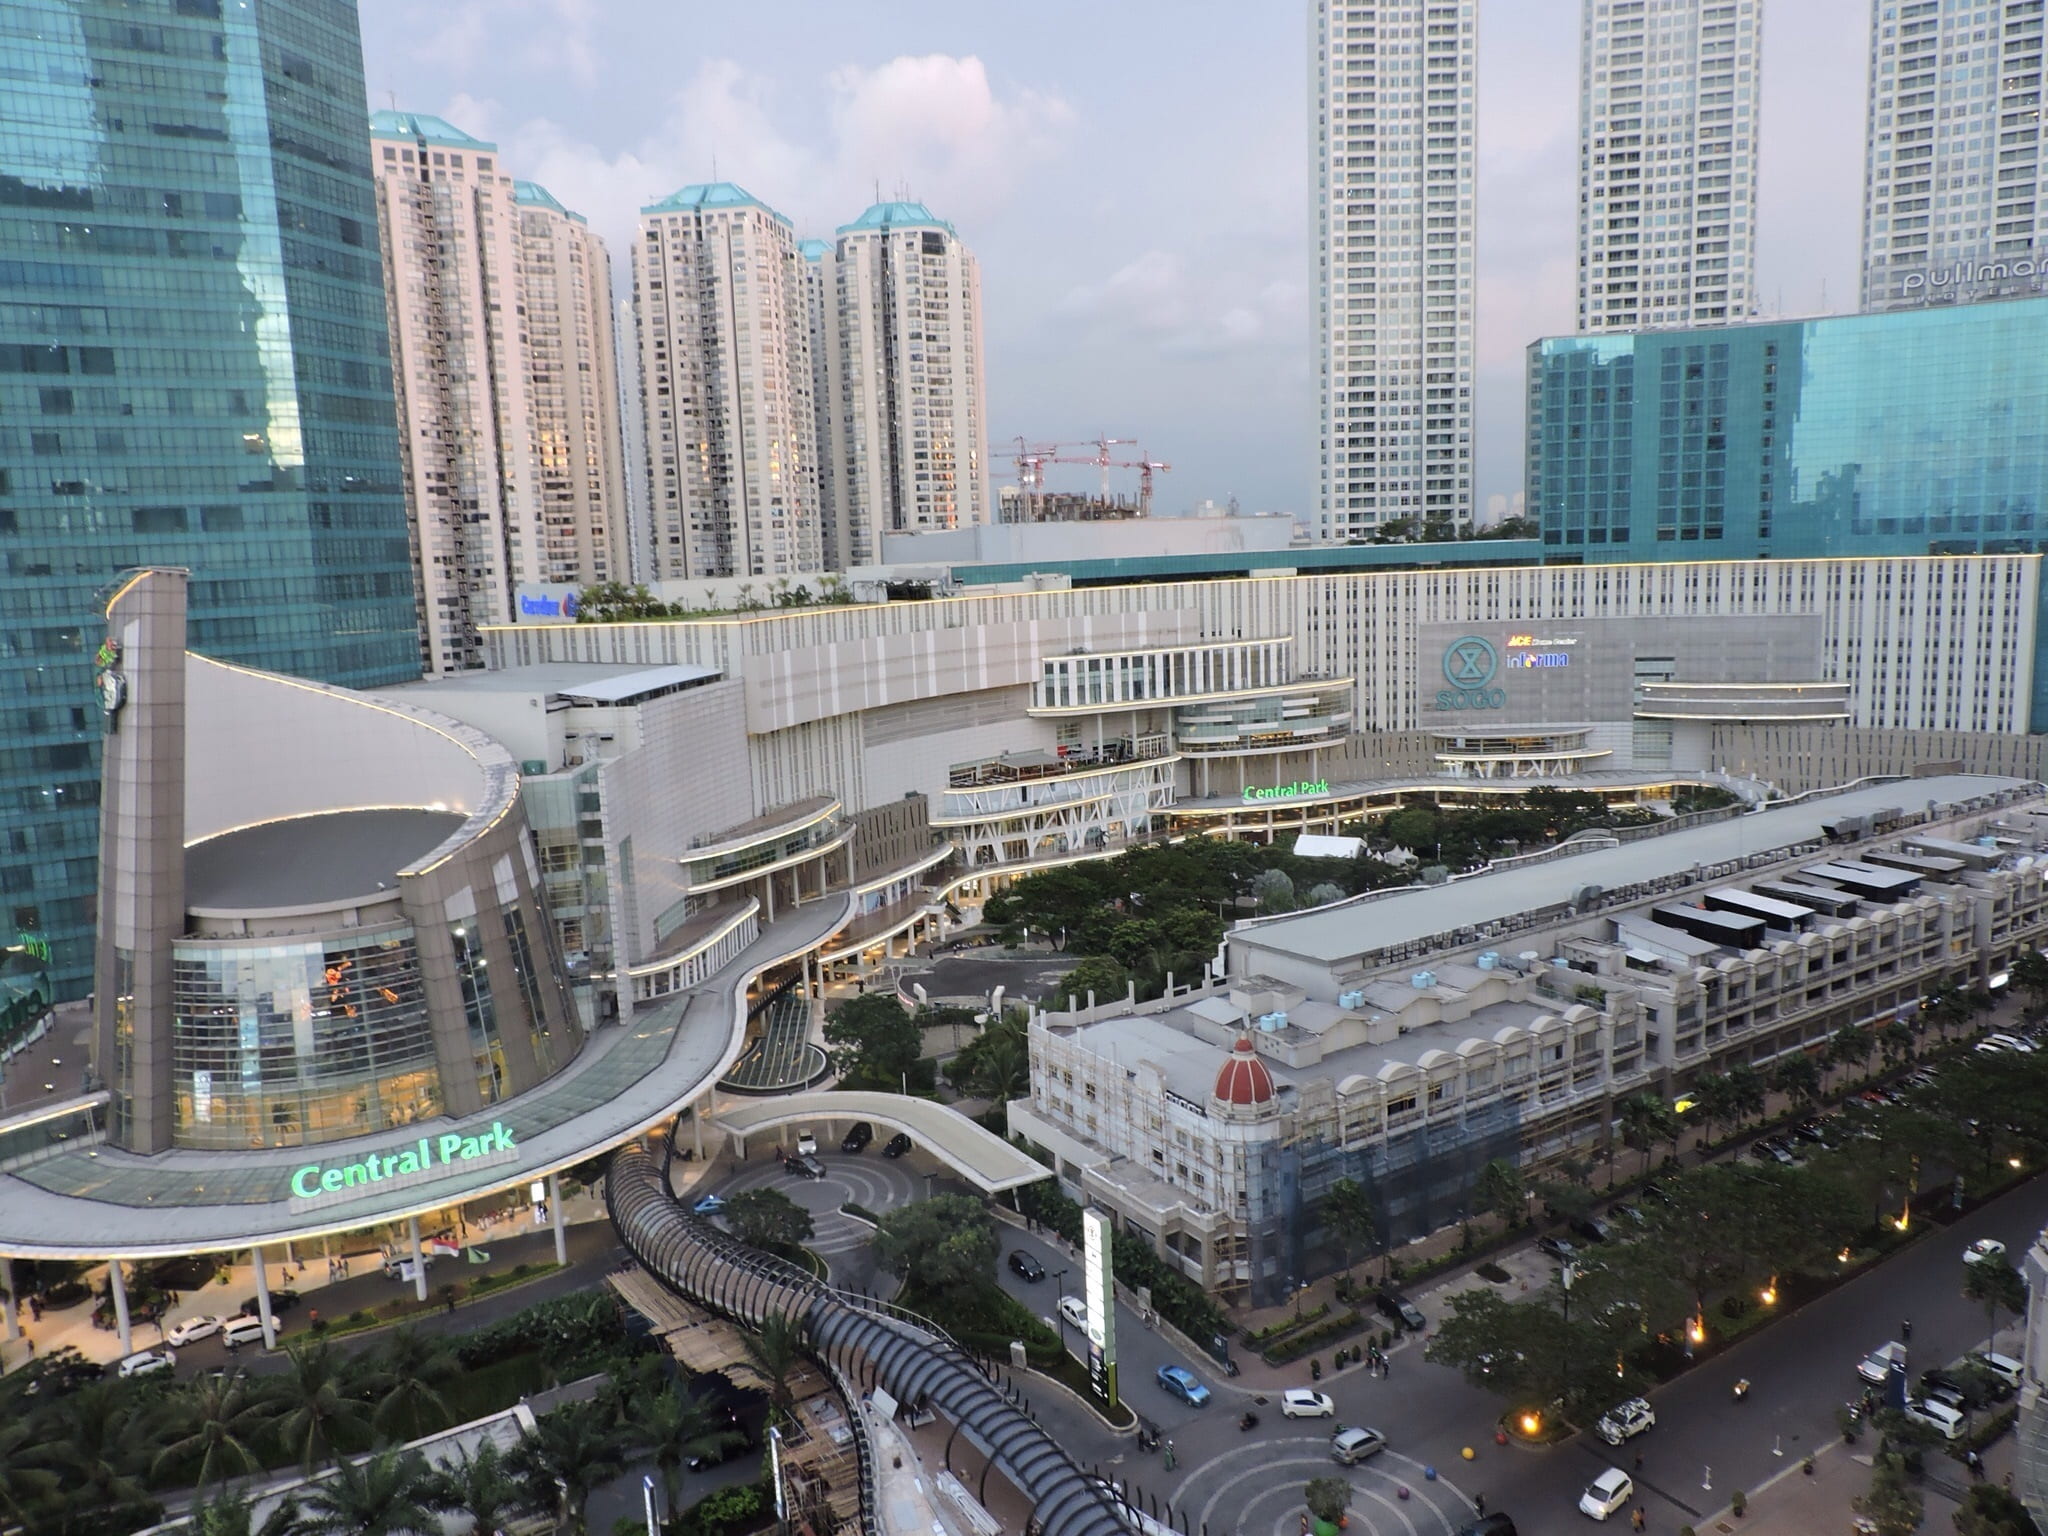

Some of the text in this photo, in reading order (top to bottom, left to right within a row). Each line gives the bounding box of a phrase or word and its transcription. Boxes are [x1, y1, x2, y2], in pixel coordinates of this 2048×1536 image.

[1507, 635, 1532, 646] ACE
[1436, 688, 1506, 711] SOGO
[1243, 778, 1329, 800] Central Park
[291, 1121, 516, 1198] Central Park
